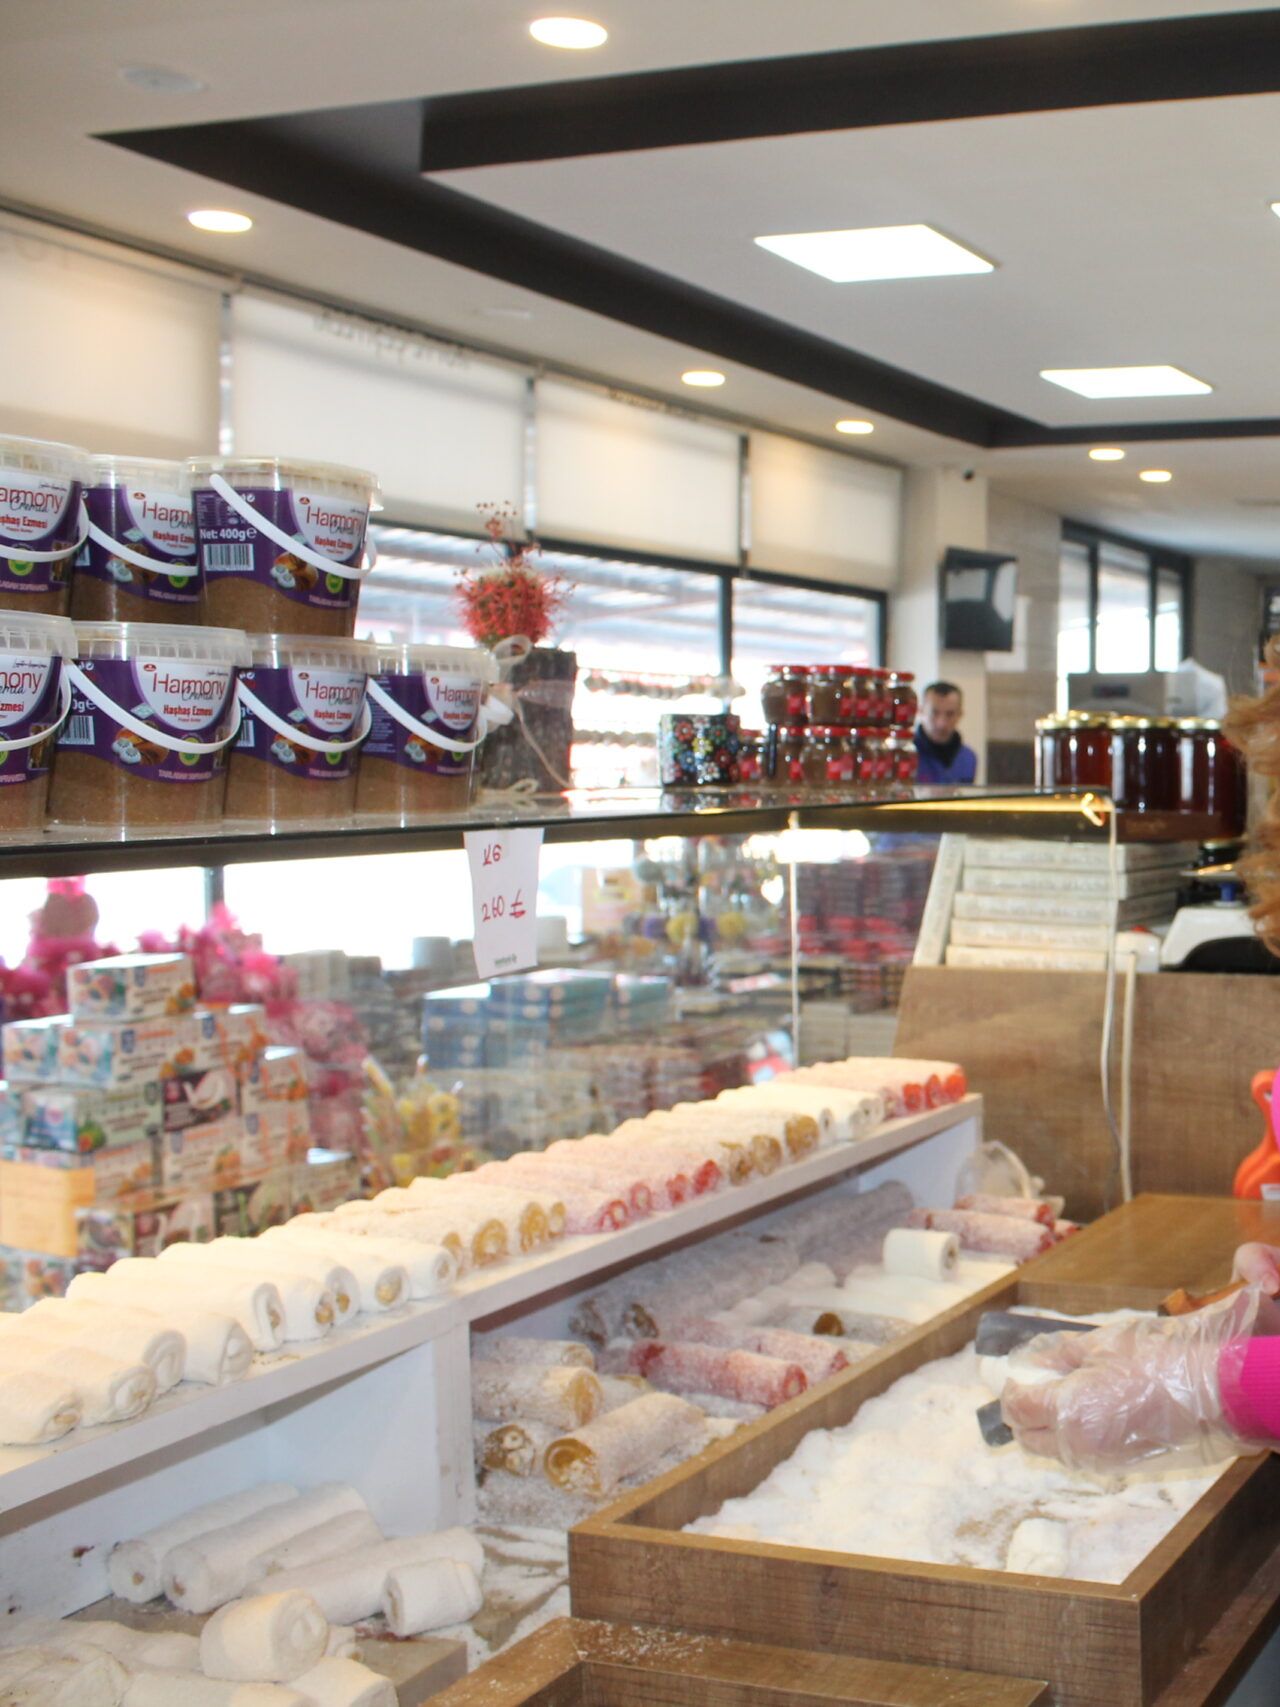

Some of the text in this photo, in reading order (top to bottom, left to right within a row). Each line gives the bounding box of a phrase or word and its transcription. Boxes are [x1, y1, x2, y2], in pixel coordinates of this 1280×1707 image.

[0, 487, 63, 514] armony
[142, 500, 195, 521] Harm
[200, 528, 218, 540] Net:
[152, 673, 225, 700] Harmony
[0, 702, 24, 712] zmesi
[482, 895, 504, 922] 260
